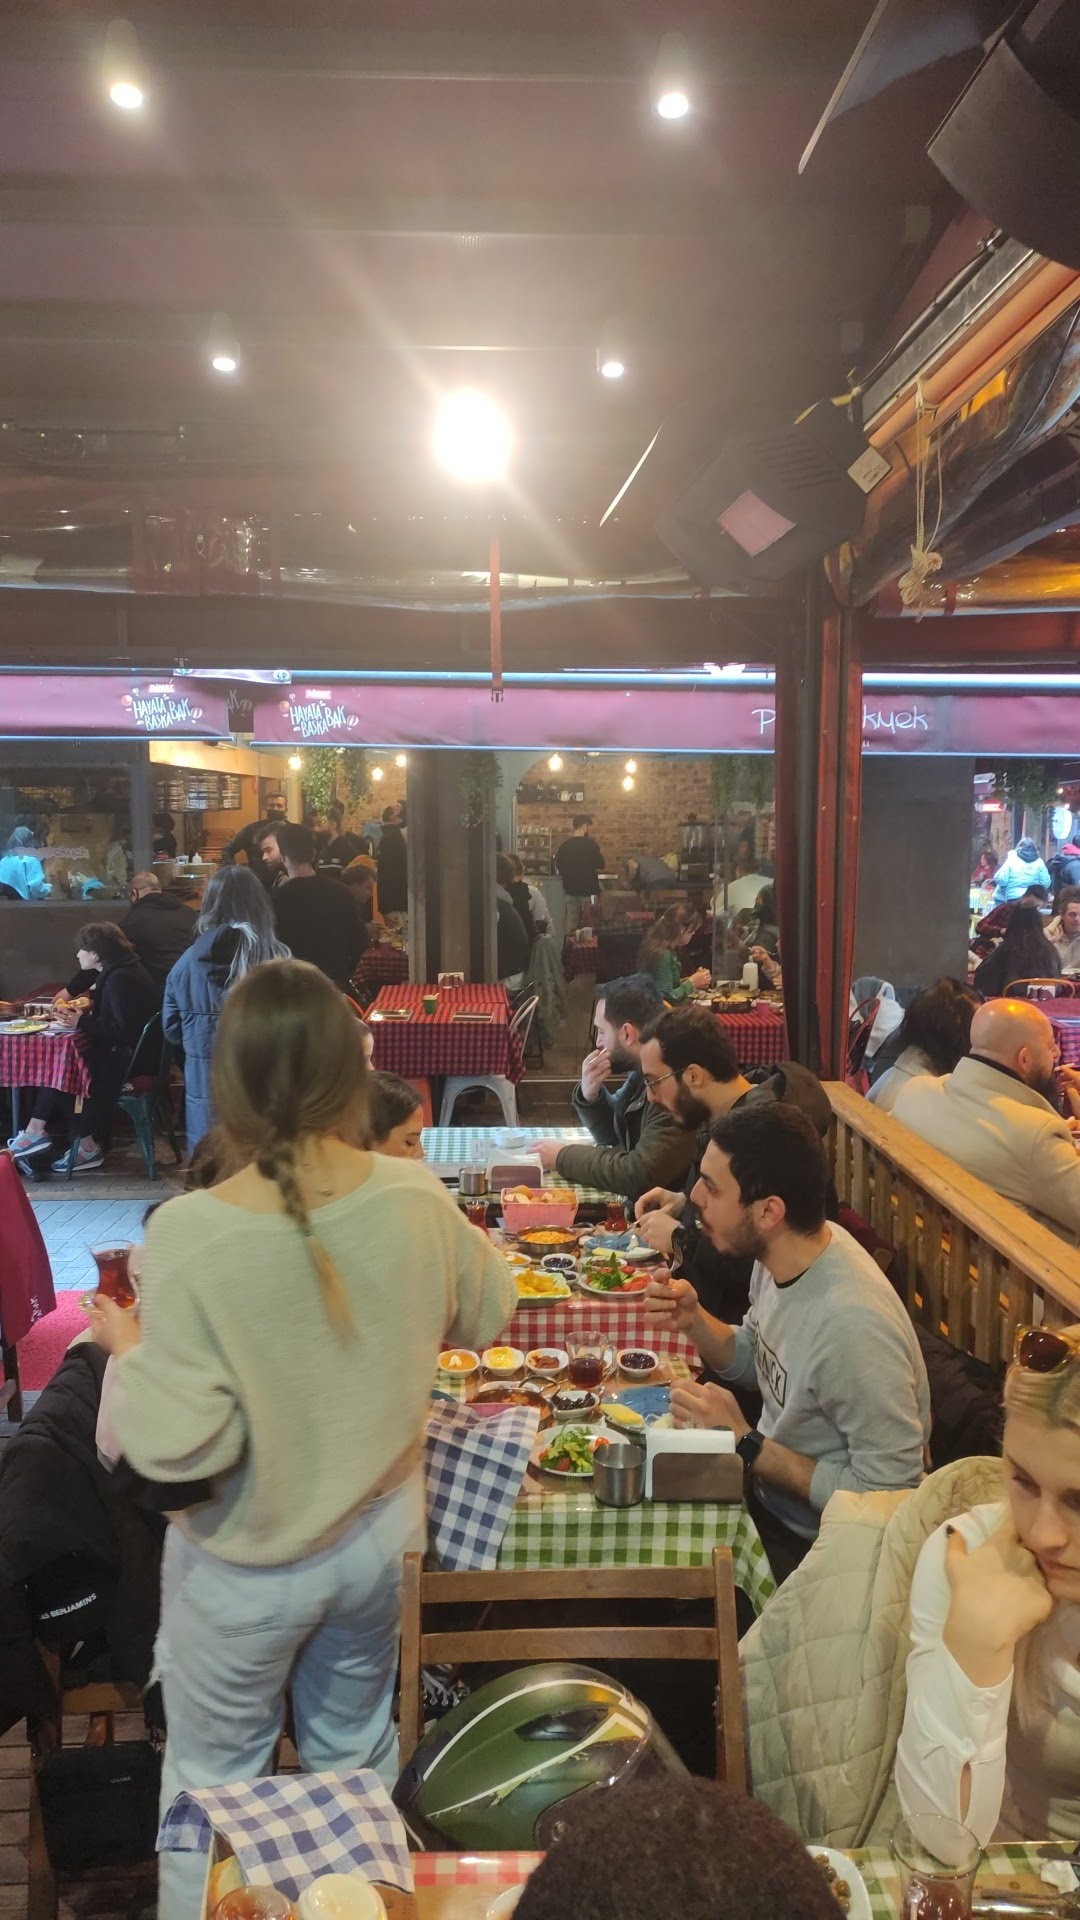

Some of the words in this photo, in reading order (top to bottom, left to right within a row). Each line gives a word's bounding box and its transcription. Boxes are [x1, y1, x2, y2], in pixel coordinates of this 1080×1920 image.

[133, 697, 166, 719] HAYATA
[169, 698, 191, 721] BAK
[290, 703, 322, 725] HAYATA
[325, 705, 346, 729] BAK
[50, 1593, 97, 1618] BENJAMINS
